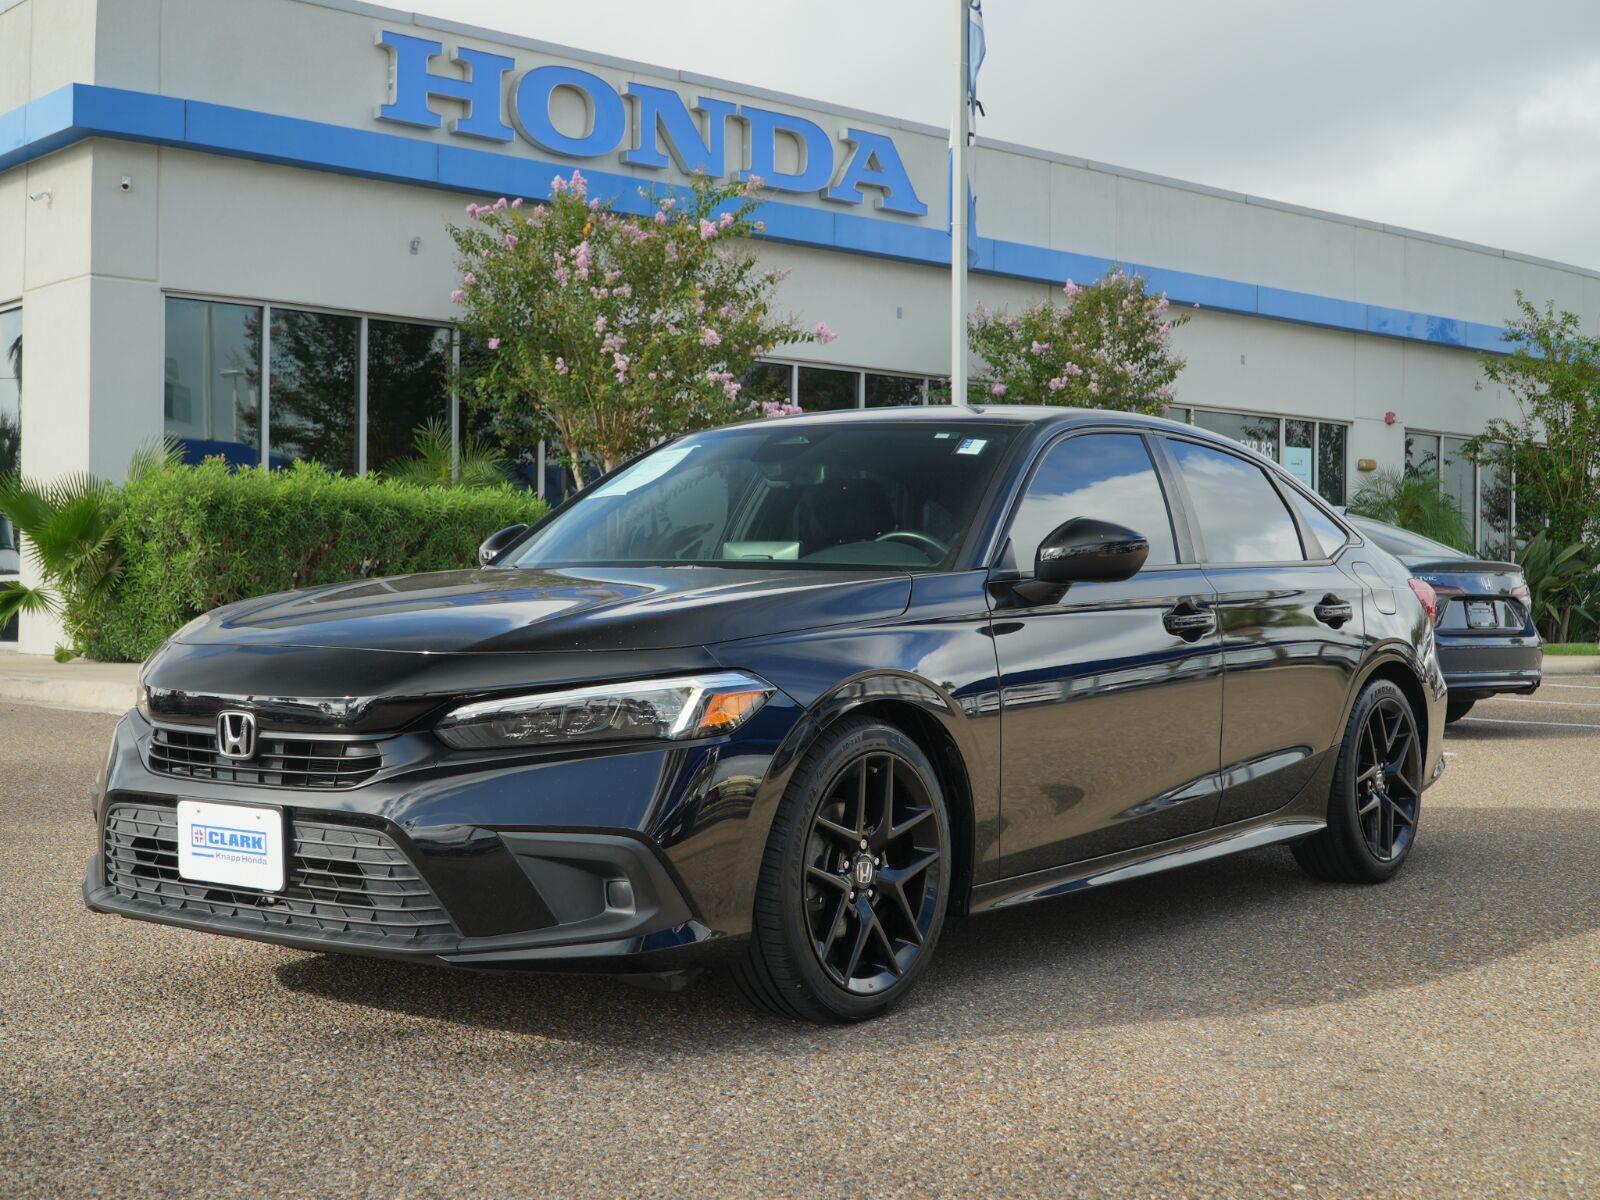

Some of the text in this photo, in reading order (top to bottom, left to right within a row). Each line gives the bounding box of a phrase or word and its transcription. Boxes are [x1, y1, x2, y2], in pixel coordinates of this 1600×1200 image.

[375, 30, 928, 217] HONDA
[208, 831, 263, 850] CLARK
[215, 852, 268, 865] Knapp Honda
